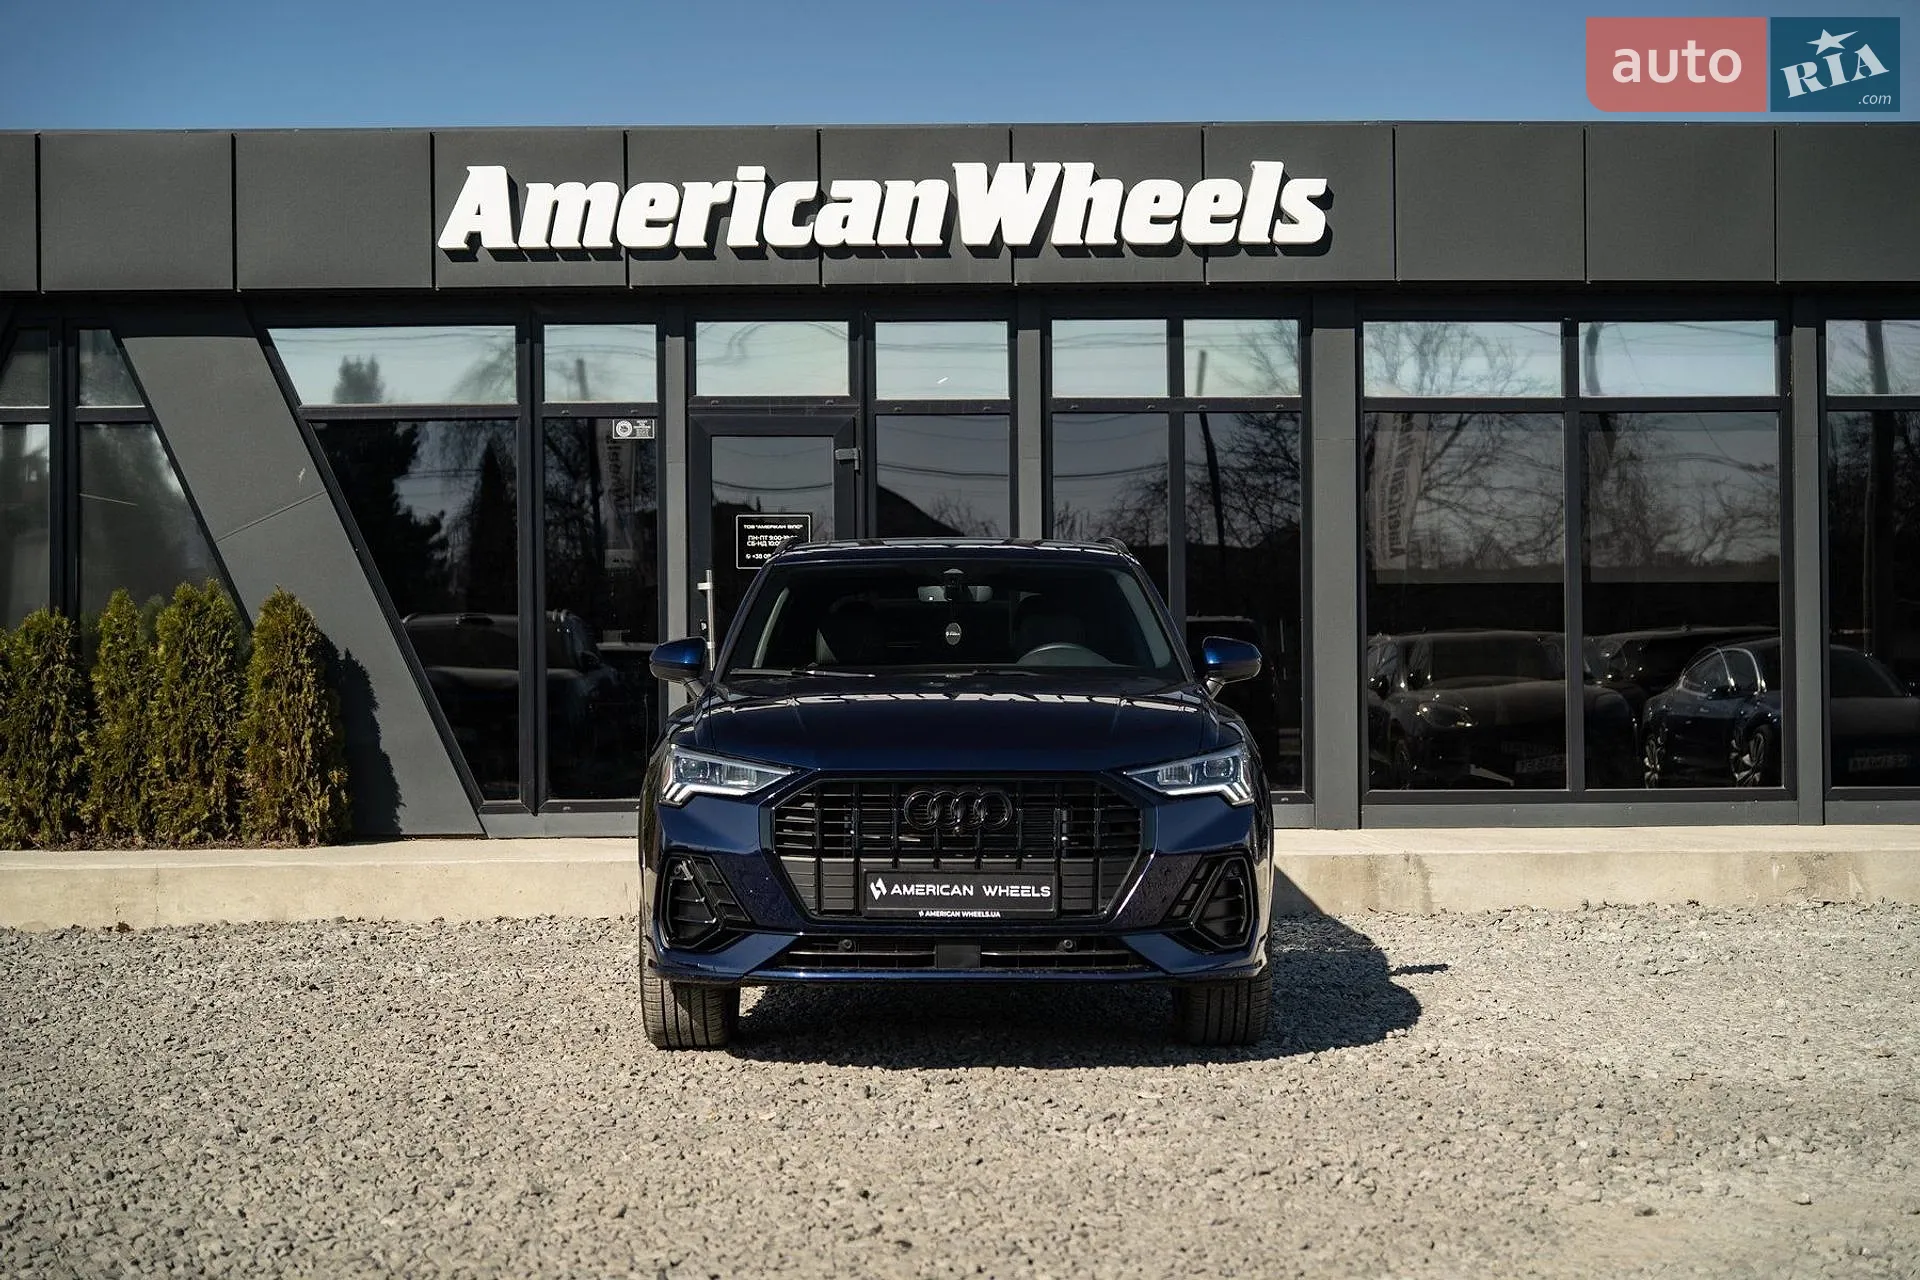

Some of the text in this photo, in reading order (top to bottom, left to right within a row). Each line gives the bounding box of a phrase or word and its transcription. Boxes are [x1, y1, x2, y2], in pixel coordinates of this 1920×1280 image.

[437, 161, 1328, 249] AmericanWheels
[890, 884, 1051, 897] AMERICAN WHEELS
[925, 910, 1001, 918] AMERICAN WHEELS.UA
